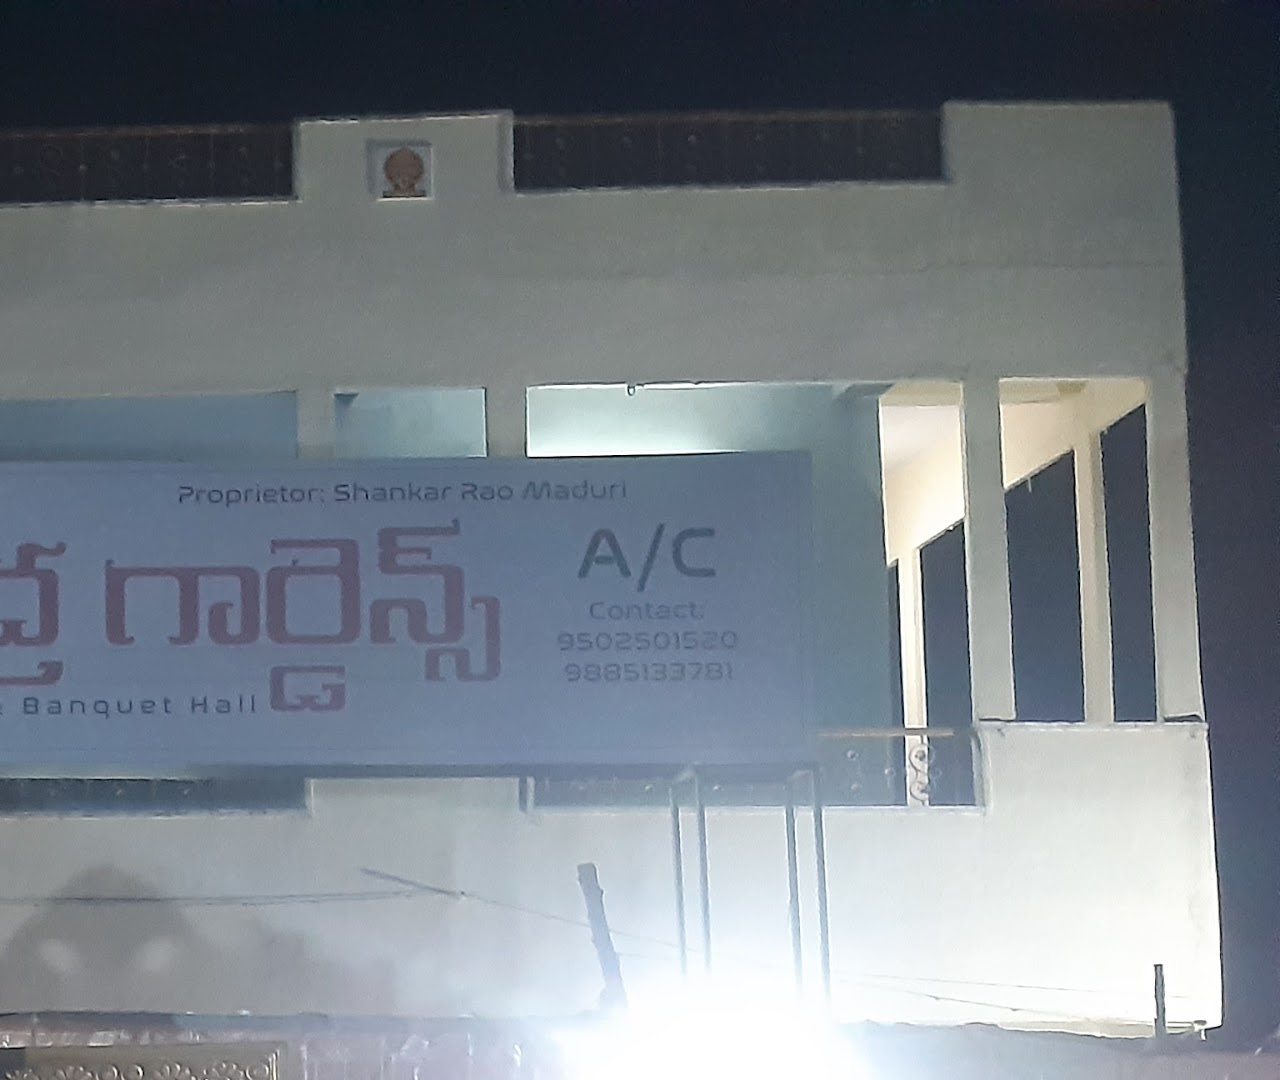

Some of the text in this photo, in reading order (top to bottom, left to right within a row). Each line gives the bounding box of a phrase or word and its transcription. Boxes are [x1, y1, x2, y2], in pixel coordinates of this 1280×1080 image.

[333, 481, 452, 501] Shankar
[461, 481, 514, 501] Rao
[522, 479, 627, 500] Maduri
[577, 522, 717, 593] A/C
[22, 696, 173, 720] Banquet
[190, 694, 256, 715] Hall
